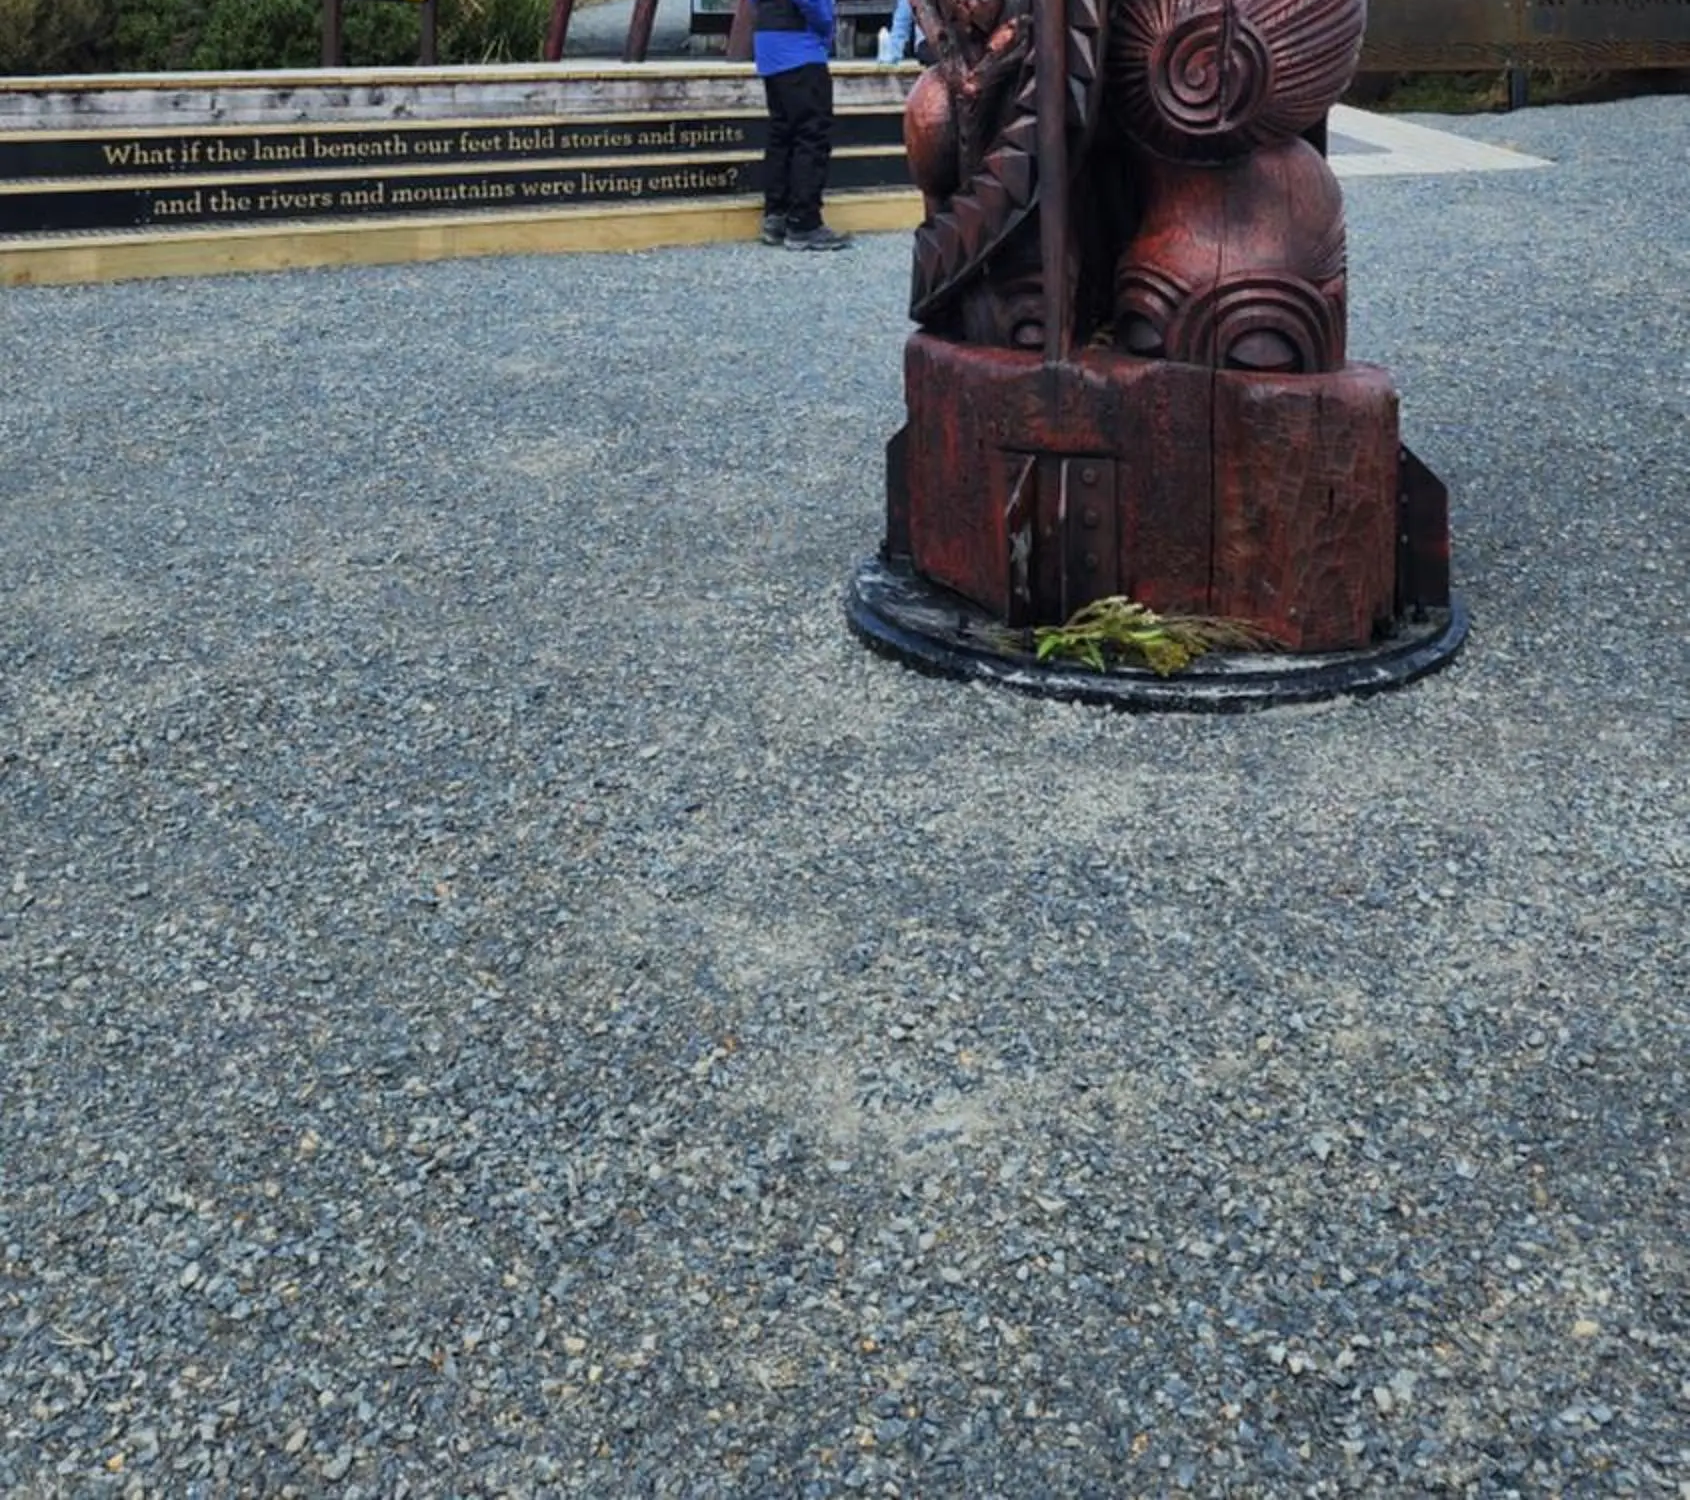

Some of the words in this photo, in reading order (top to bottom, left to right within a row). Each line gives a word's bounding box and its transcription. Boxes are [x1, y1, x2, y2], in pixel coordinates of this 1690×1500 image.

[103, 141, 176, 165] What
[181, 140, 202, 163] if
[206, 140, 247, 162] the
[254, 137, 306, 160] land
[313, 134, 408, 158] beneath
[414, 137, 453, 155] our
[459, 131, 502, 153] feet
[508, 129, 555, 151] held
[560, 129, 632, 149] stories
[637, 123, 676, 146] and
[680, 124, 744, 149] spirits
[154, 190, 201, 215] and
[209, 189, 251, 213] the
[258, 189, 333, 209] rivers
[340, 183, 384, 205] and
[391, 180, 515, 204] mountains
[521, 179, 576, 197] were
[581, 171, 643, 196] living
[648, 167, 739, 191] entities?
